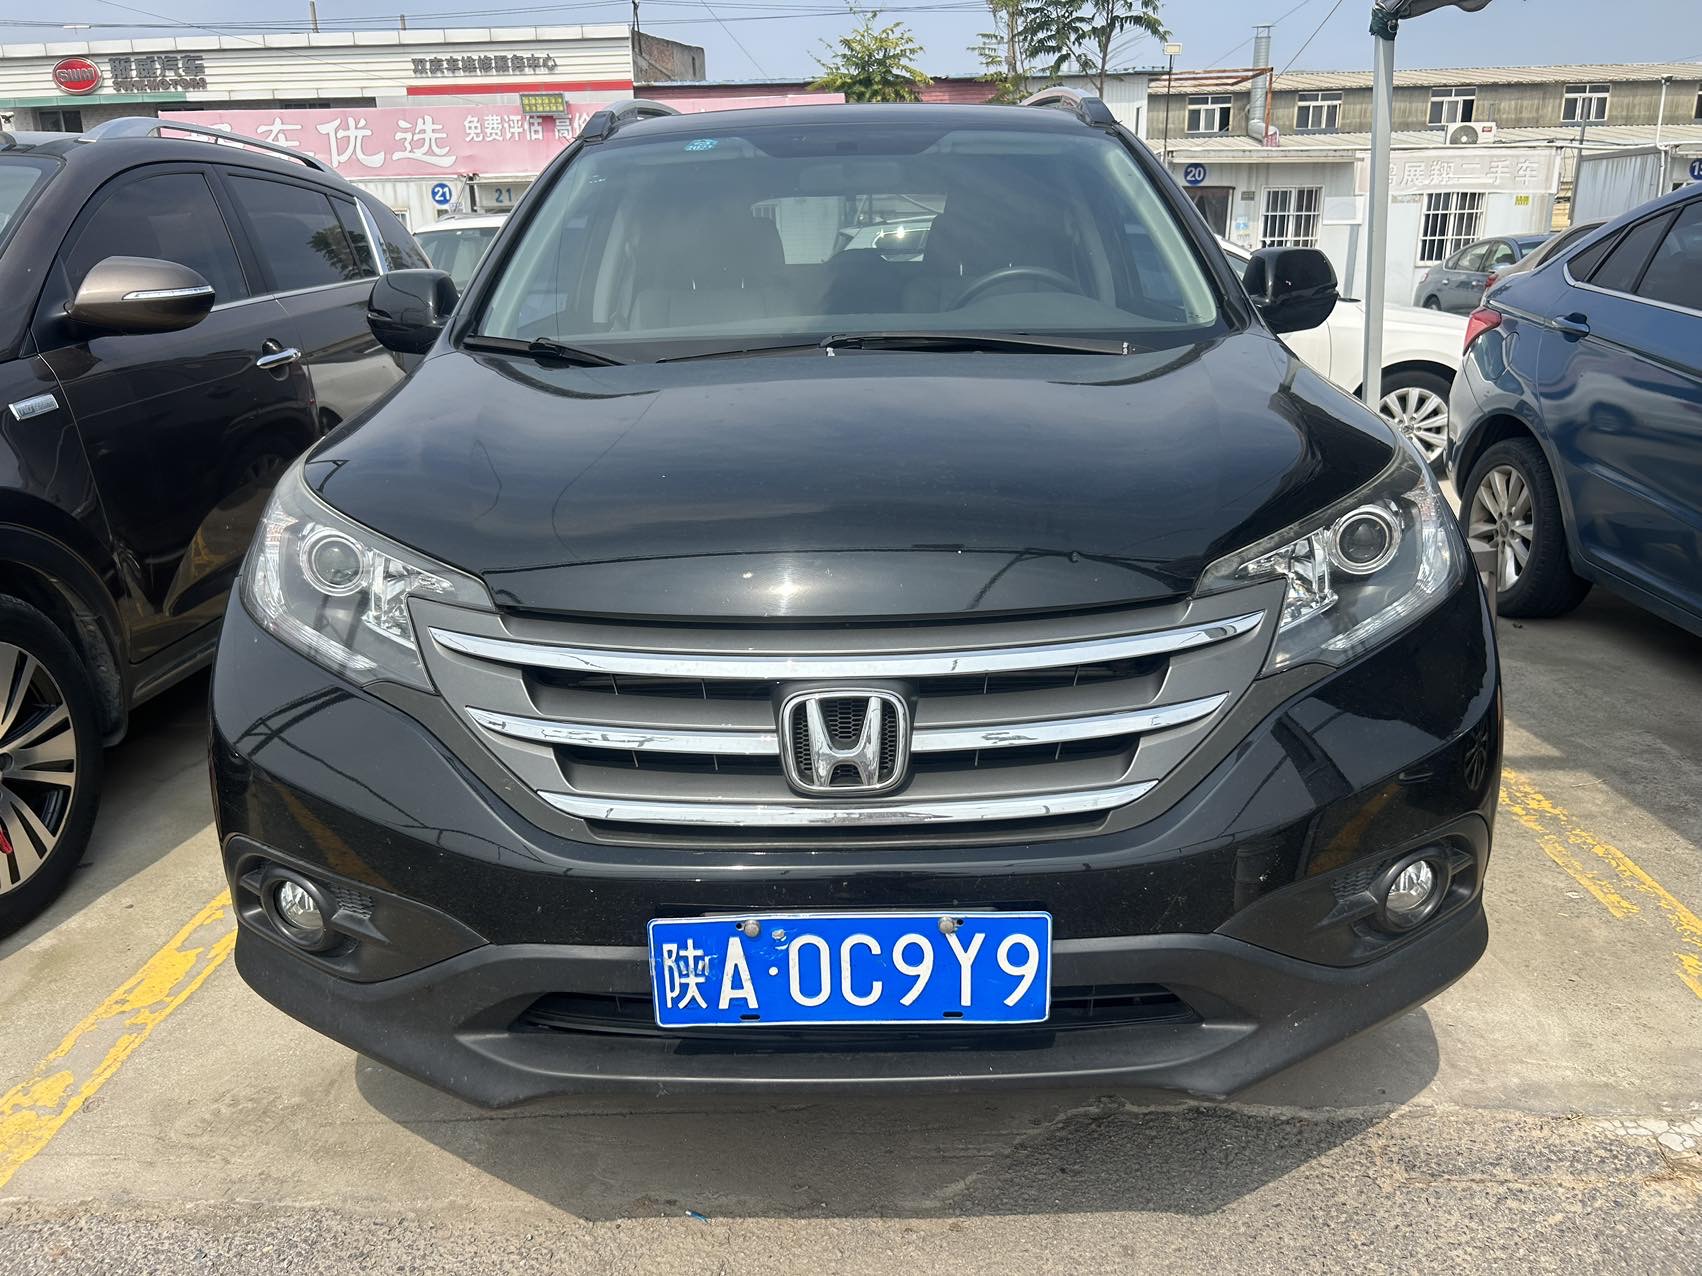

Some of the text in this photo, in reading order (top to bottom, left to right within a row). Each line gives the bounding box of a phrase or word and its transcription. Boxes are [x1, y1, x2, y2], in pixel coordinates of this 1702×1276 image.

[463, 114, 544, 142] 免费评估
[1186, 167, 1204, 181] 20
[434, 187, 450, 201] 21
[495, 188, 512, 203] 21
